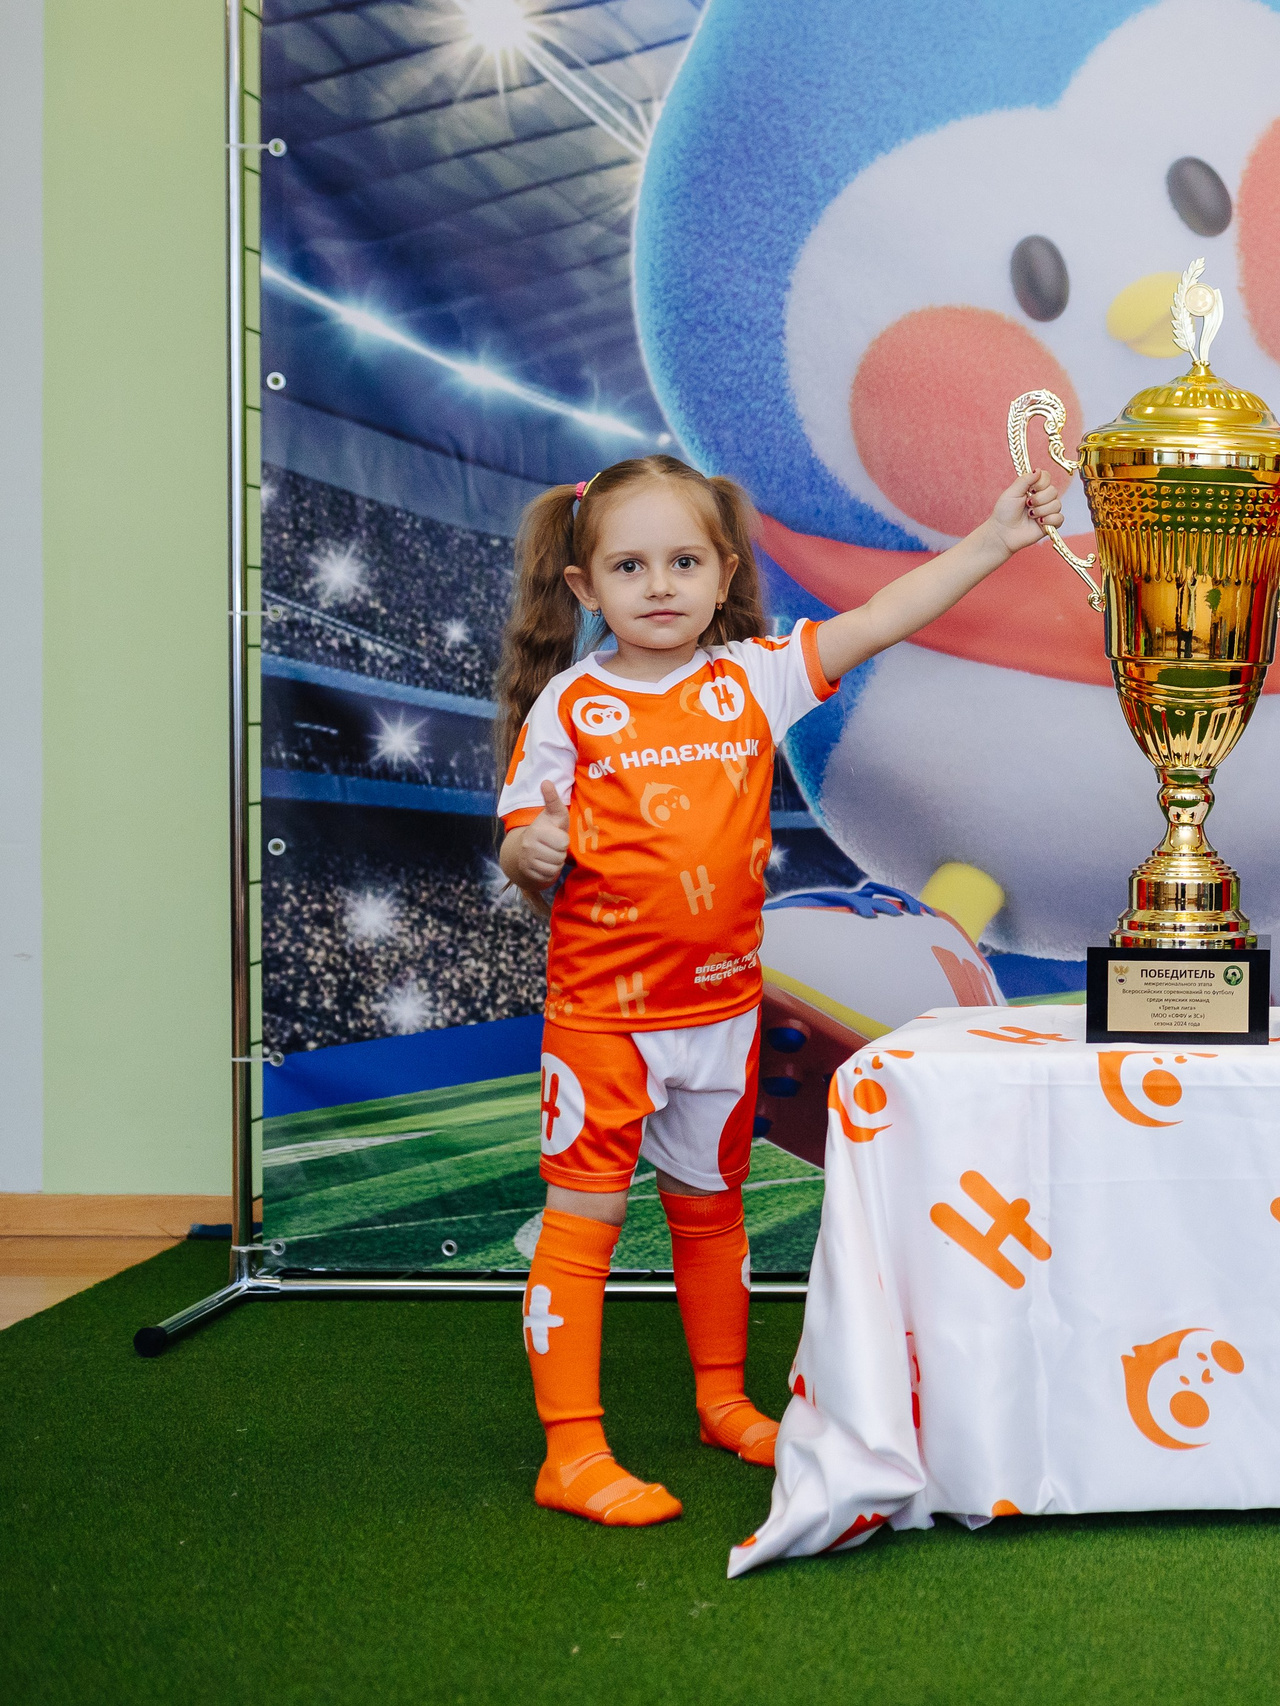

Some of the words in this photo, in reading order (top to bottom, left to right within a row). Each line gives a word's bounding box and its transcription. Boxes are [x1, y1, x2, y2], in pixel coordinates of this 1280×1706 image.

[587, 755, 617, 780] ФК
[619, 738, 760, 769] НАДЕЖДИК
[694, 969, 733, 984] ВМЕСТЕ
[732, 964, 747, 975] МЫ
[695, 959, 733, 975] ВПЕРЁД
[1140, 968, 1216, 981] ПОБЕДИТЕЛЬ
[1163, 988, 1203, 996] соревнований
[1211, 989, 1235, 997] футболу
[1150, 1012, 1168, 1020] (МОО
[1168, 1012, 1187, 1020] «СФФУ
